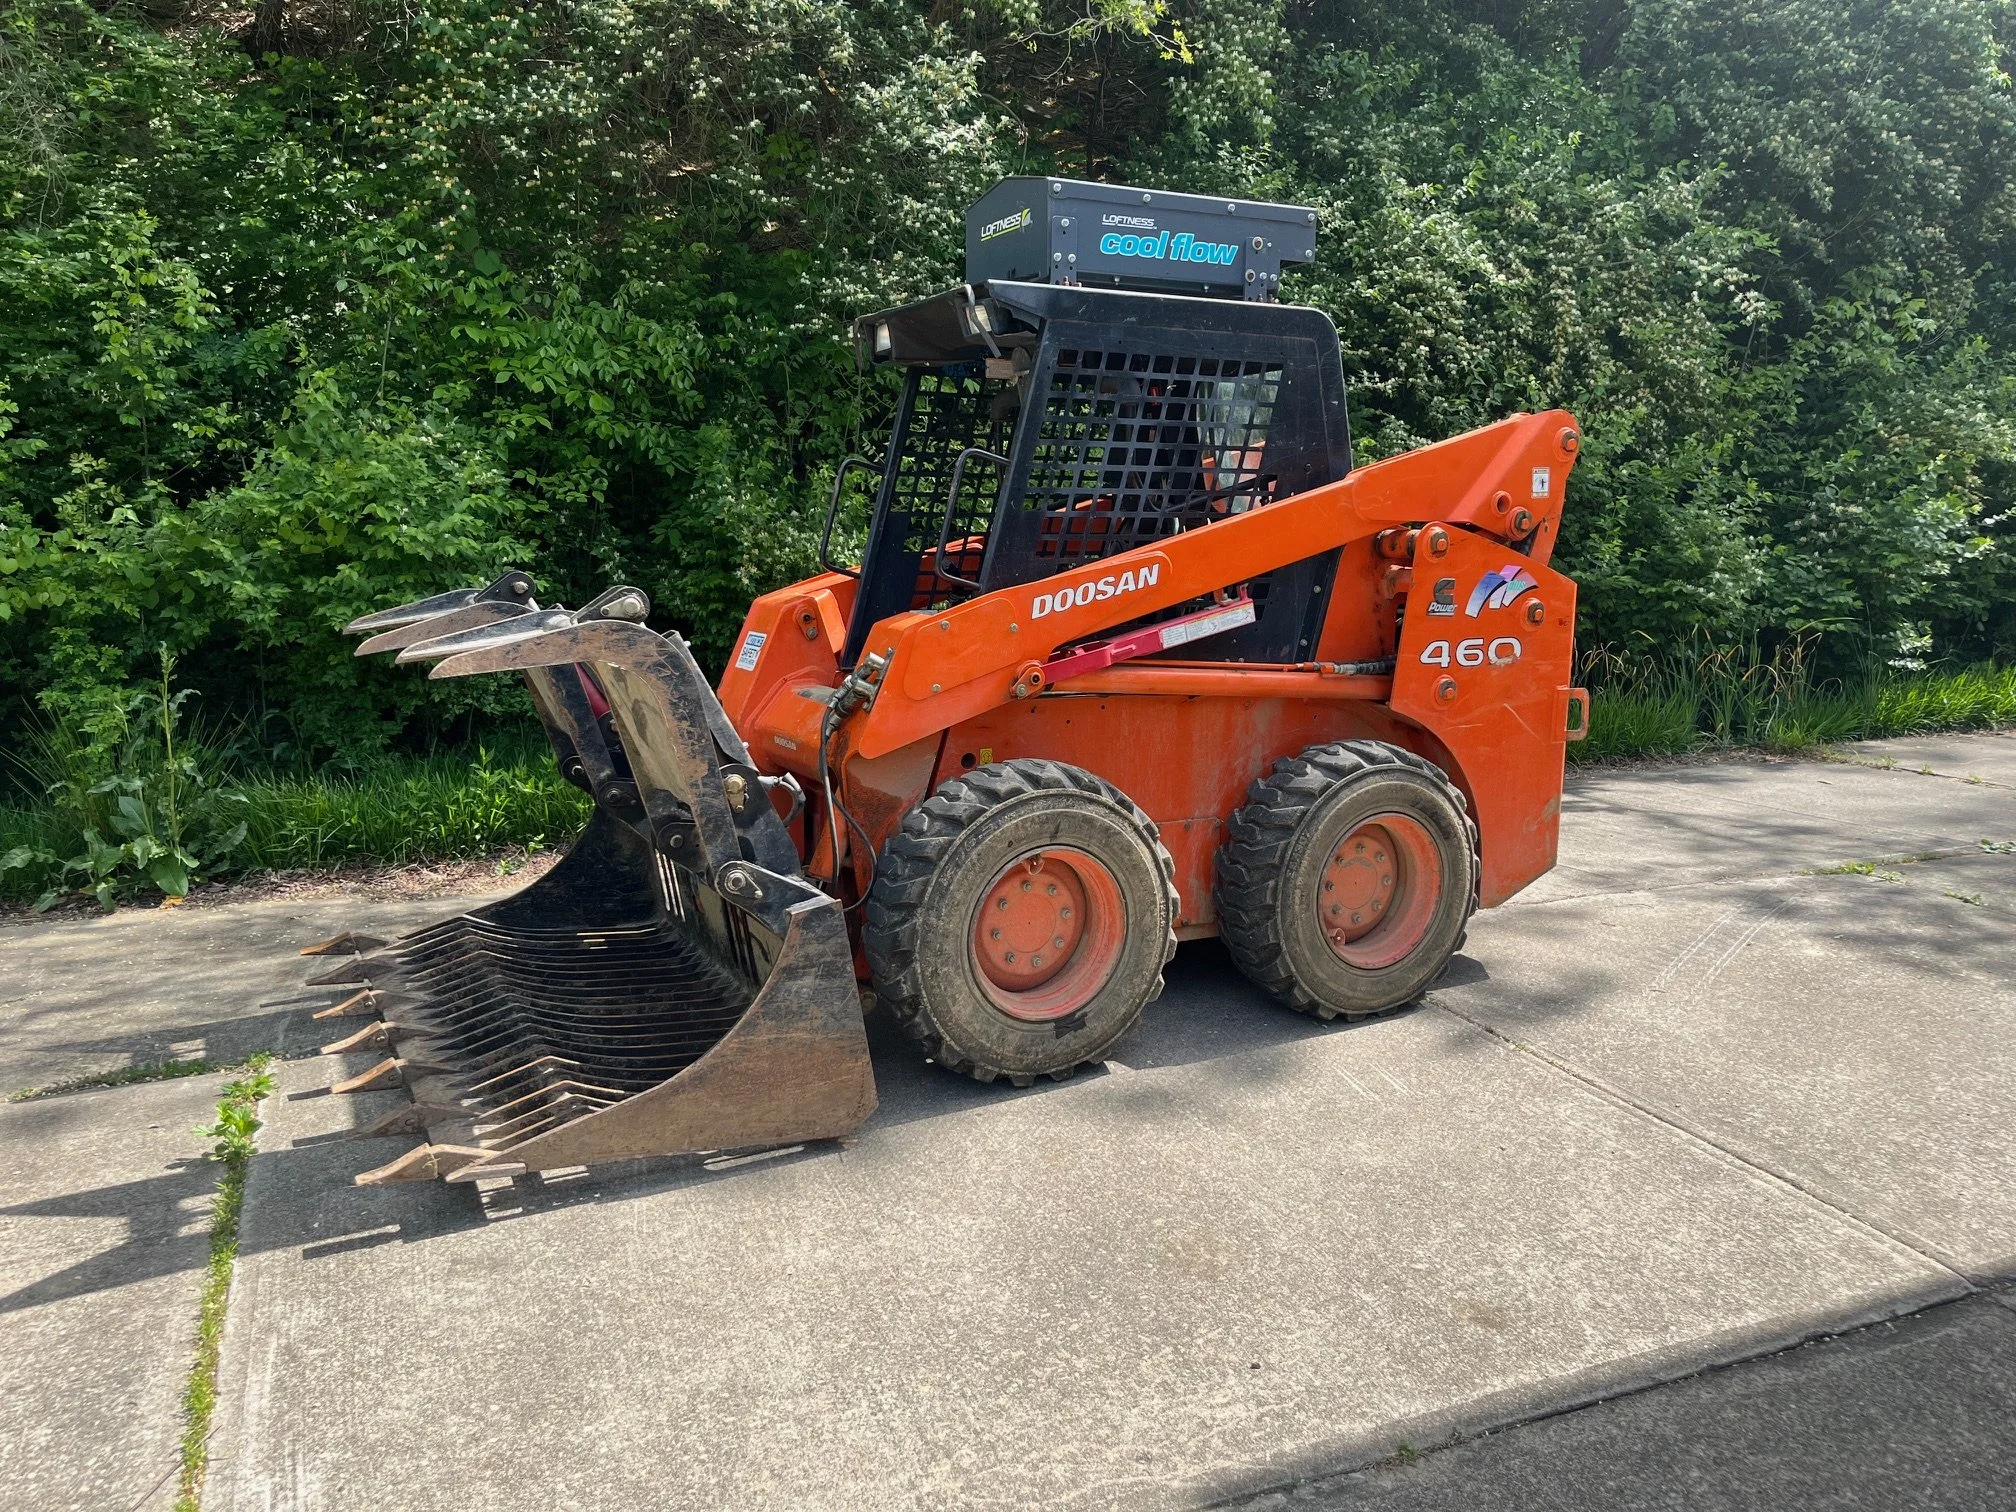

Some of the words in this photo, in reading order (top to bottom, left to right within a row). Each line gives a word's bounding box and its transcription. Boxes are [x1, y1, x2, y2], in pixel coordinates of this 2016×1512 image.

[981, 211, 1022, 238] LOFTNESS
[1102, 213, 1155, 227] LOFTNESS
[1100, 230, 1170, 259] cool
[1170, 232, 1238, 265] flow
[1031, 563, 1160, 619] DOOSAN
[1428, 601, 1458, 612] Power
[1419, 636, 1523, 668] 460
